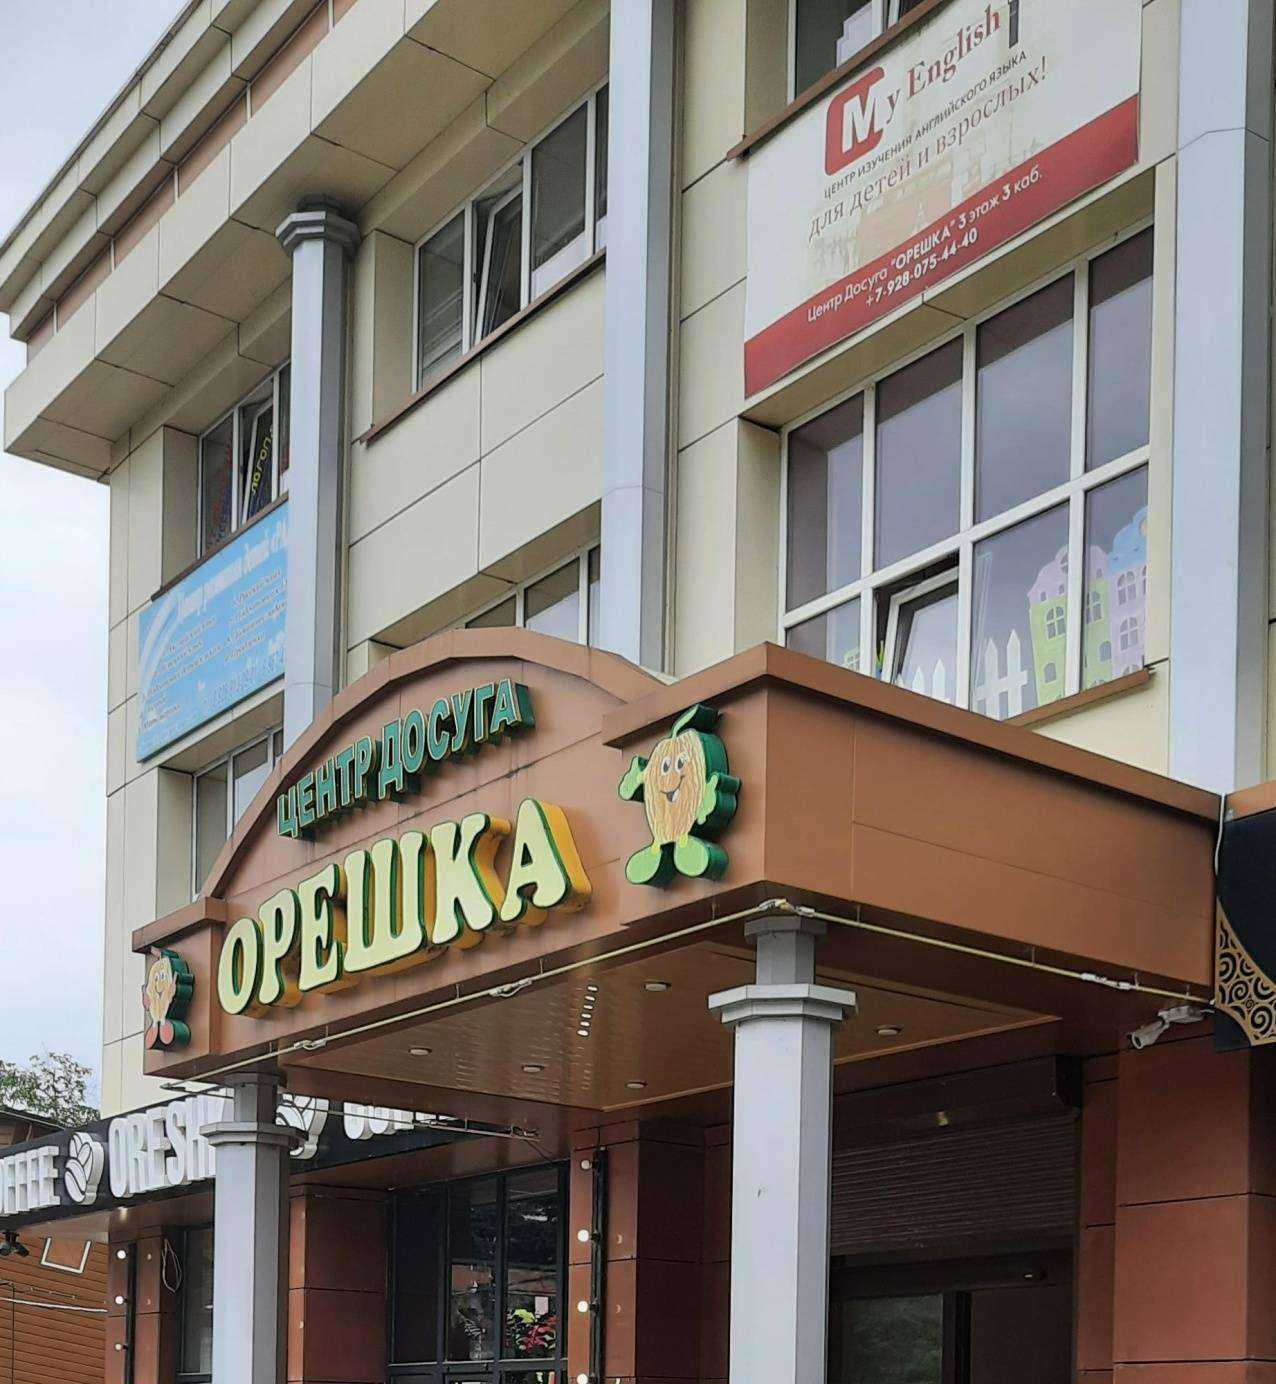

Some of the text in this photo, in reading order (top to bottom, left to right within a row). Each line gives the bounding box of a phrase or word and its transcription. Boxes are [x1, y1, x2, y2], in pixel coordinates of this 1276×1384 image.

[824, 50, 1028, 200] ЦЕНТР ИЗУЧЕНИЯ АНГЛИЙСКОГО ЯЗЫКА
[907, 3, 1001, 101] English
[808, 54, 1047, 243] для детей и взрослых!
[807, 294, 842, 322] Центр
[844, 267, 888, 303] Досуга
[958, 211, 967, 230] 3
[968, 194, 1000, 223] этаж
[1001, 182, 1012, 201] 3
[1014, 163, 1043, 195] каб.
[277, 677, 527, 839] ЦЕНТР ДОСУГА
[217, 797, 580, 1018] ОРЕШКА
[0, 1145, 61, 1217] FFEE
